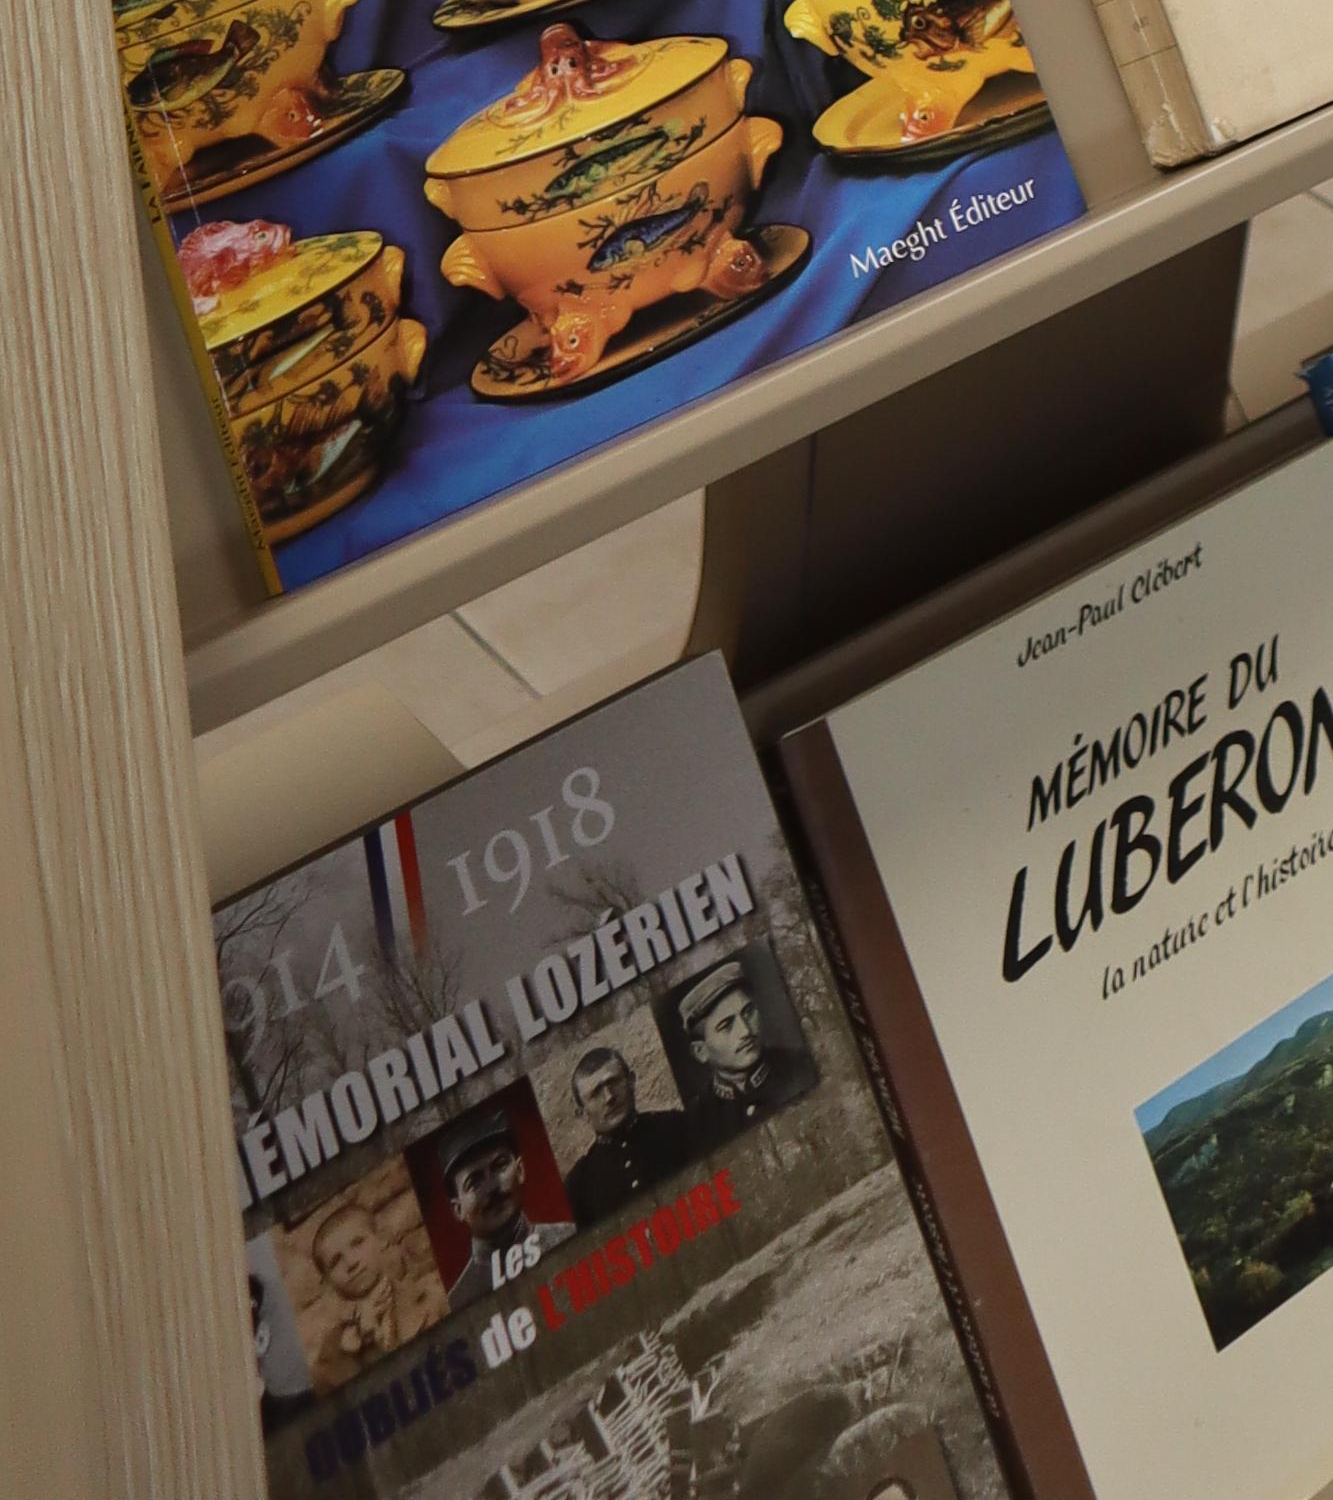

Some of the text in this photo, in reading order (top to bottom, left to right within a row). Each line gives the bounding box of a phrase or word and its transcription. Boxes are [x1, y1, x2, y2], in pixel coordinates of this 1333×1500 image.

[850, 178, 1037, 278] Maeght Éditeur
[1015, 542, 1204, 671] Jean-Paul Clébert
[1025, 634, 1283, 834] MÉMOIRE DU
[445, 766, 620, 917] 1918
[502, 853, 756, 1046] LOZÉRIEN
[1101, 960, 1128, 1001] la
[1129, 907, 1212, 977] nature
[1214, 884, 1240, 928] et
[480, 1304, 538, 1372] de
[537, 1168, 742, 1333] L'HISTOIRE
[491, 1231, 543, 1293] Les
